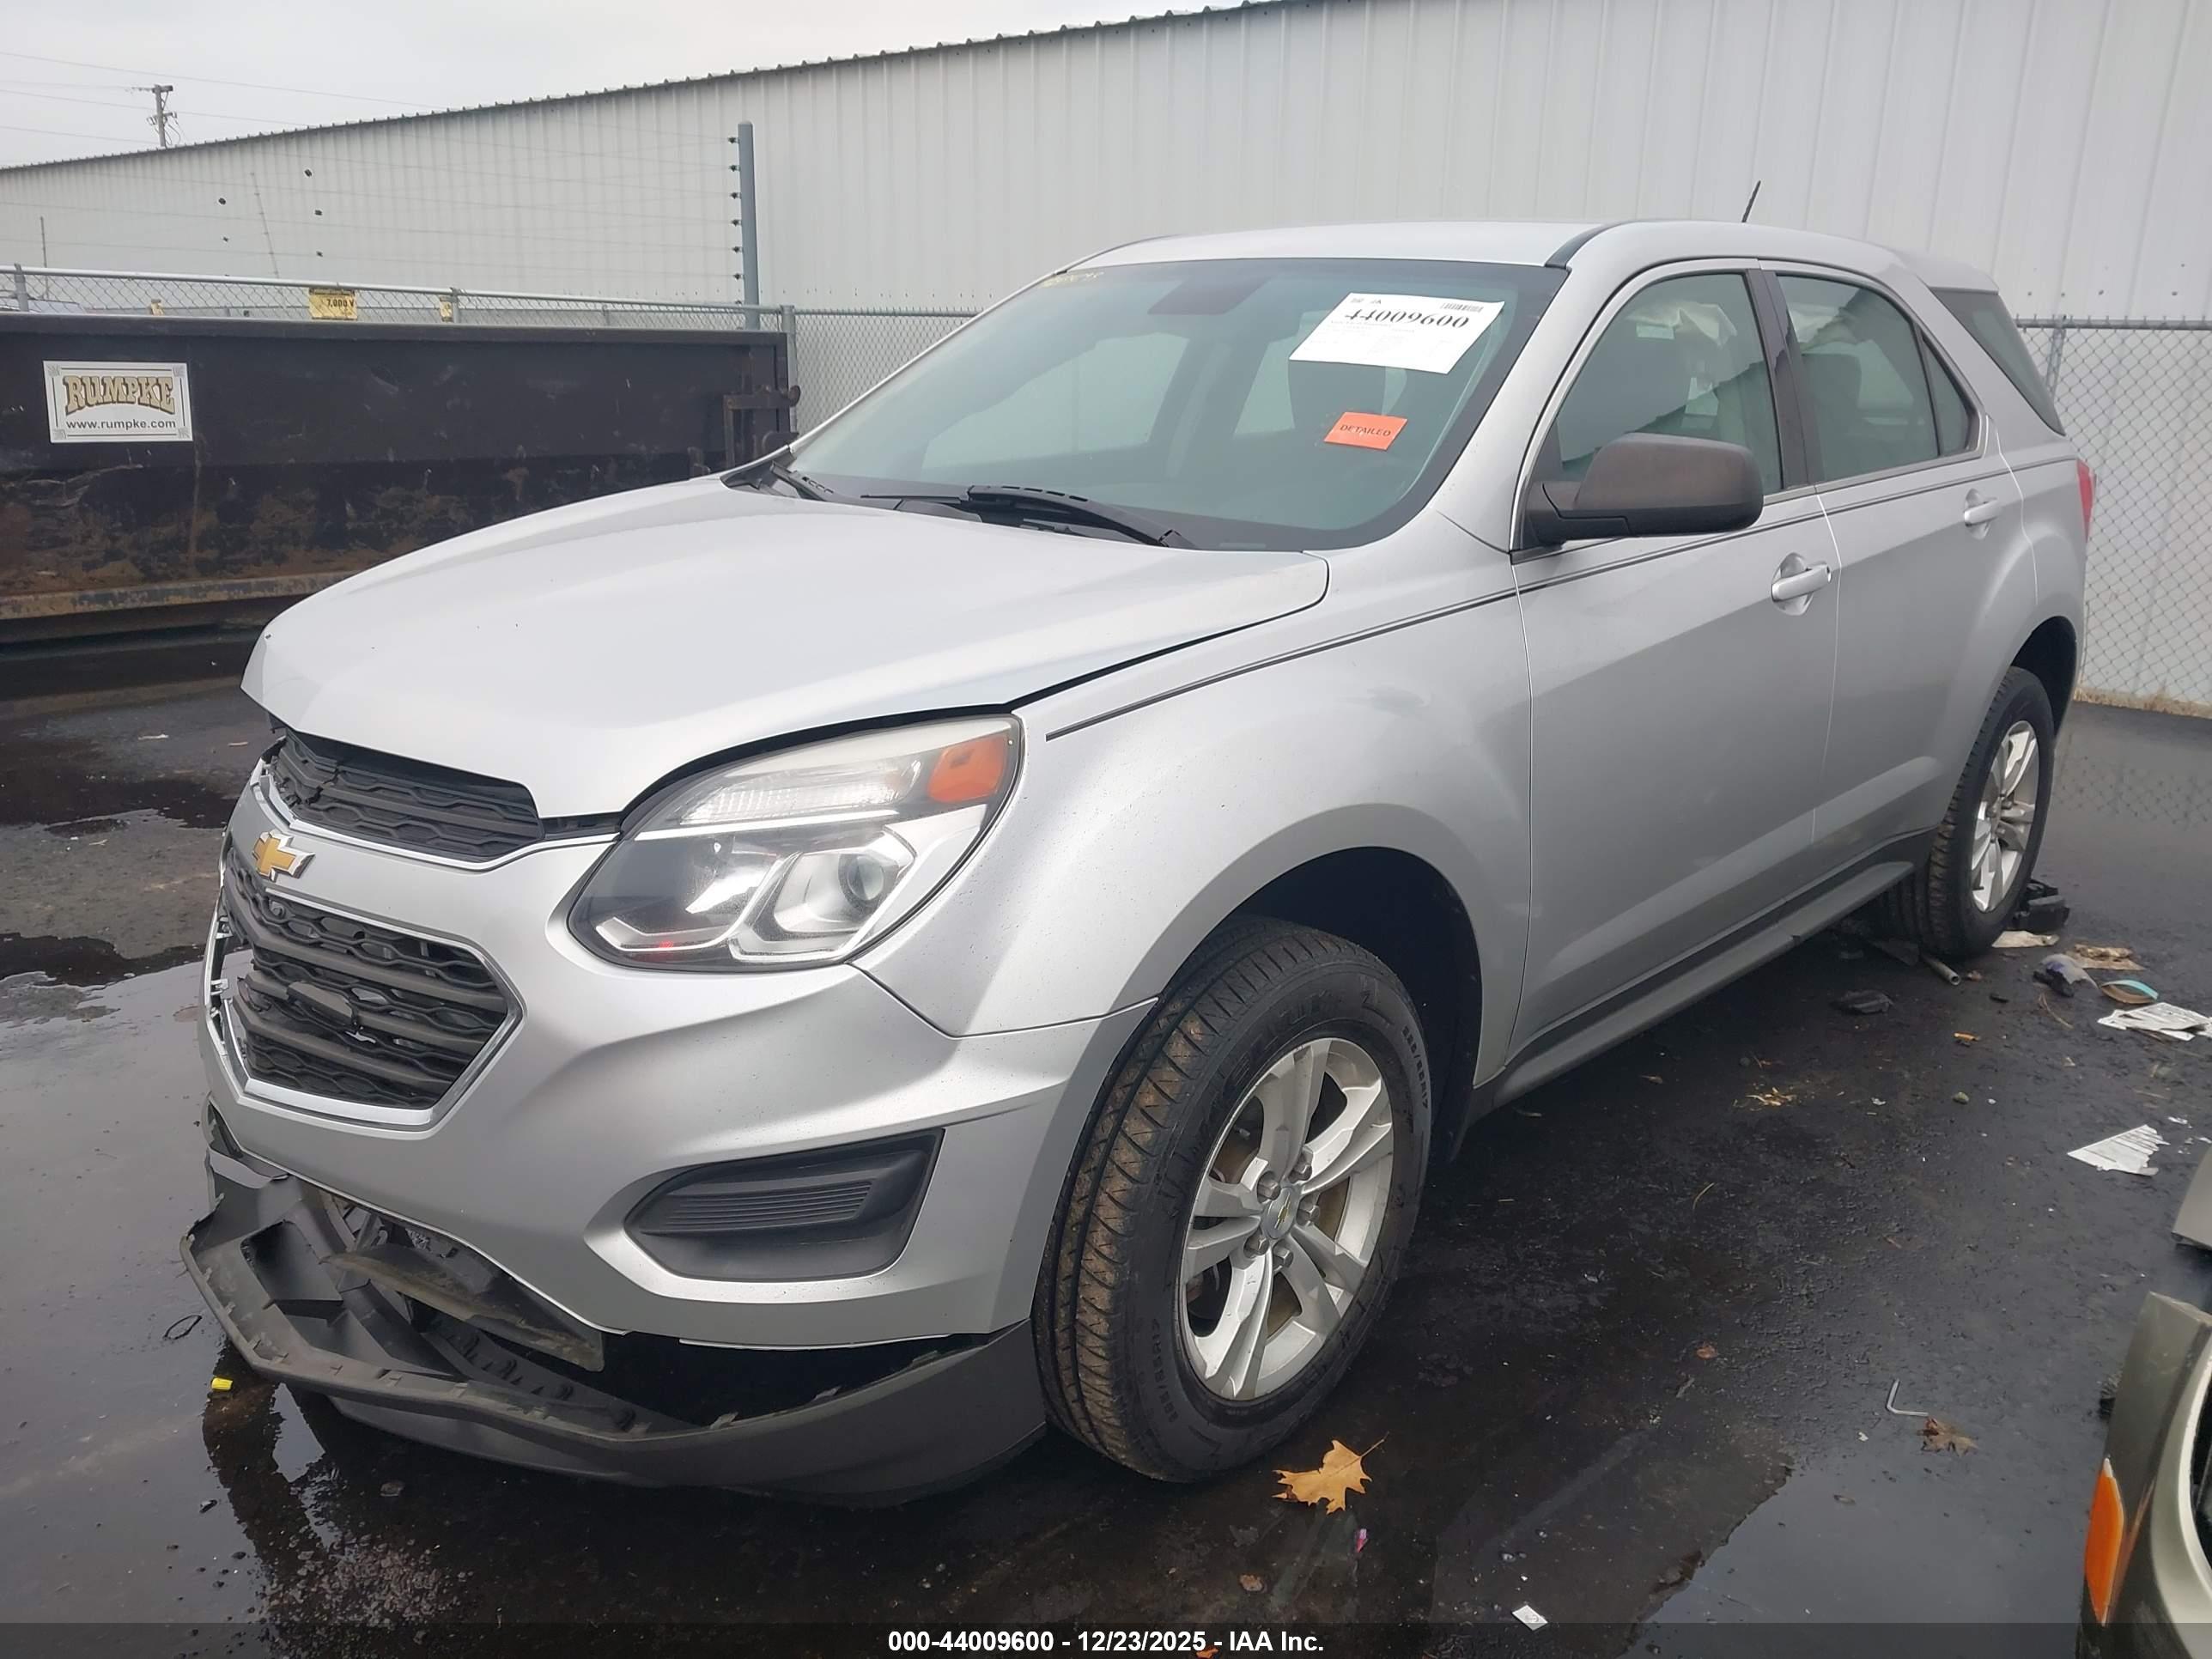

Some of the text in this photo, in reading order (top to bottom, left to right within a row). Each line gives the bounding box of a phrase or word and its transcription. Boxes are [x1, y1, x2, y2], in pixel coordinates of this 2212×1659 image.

[1345, 308, 1469, 328] 44009600
[63, 375, 175, 415] RUMPKE
[66, 419, 176, 430] www.rumpke.com
[1340, 424, 1392, 437] DETAILED
